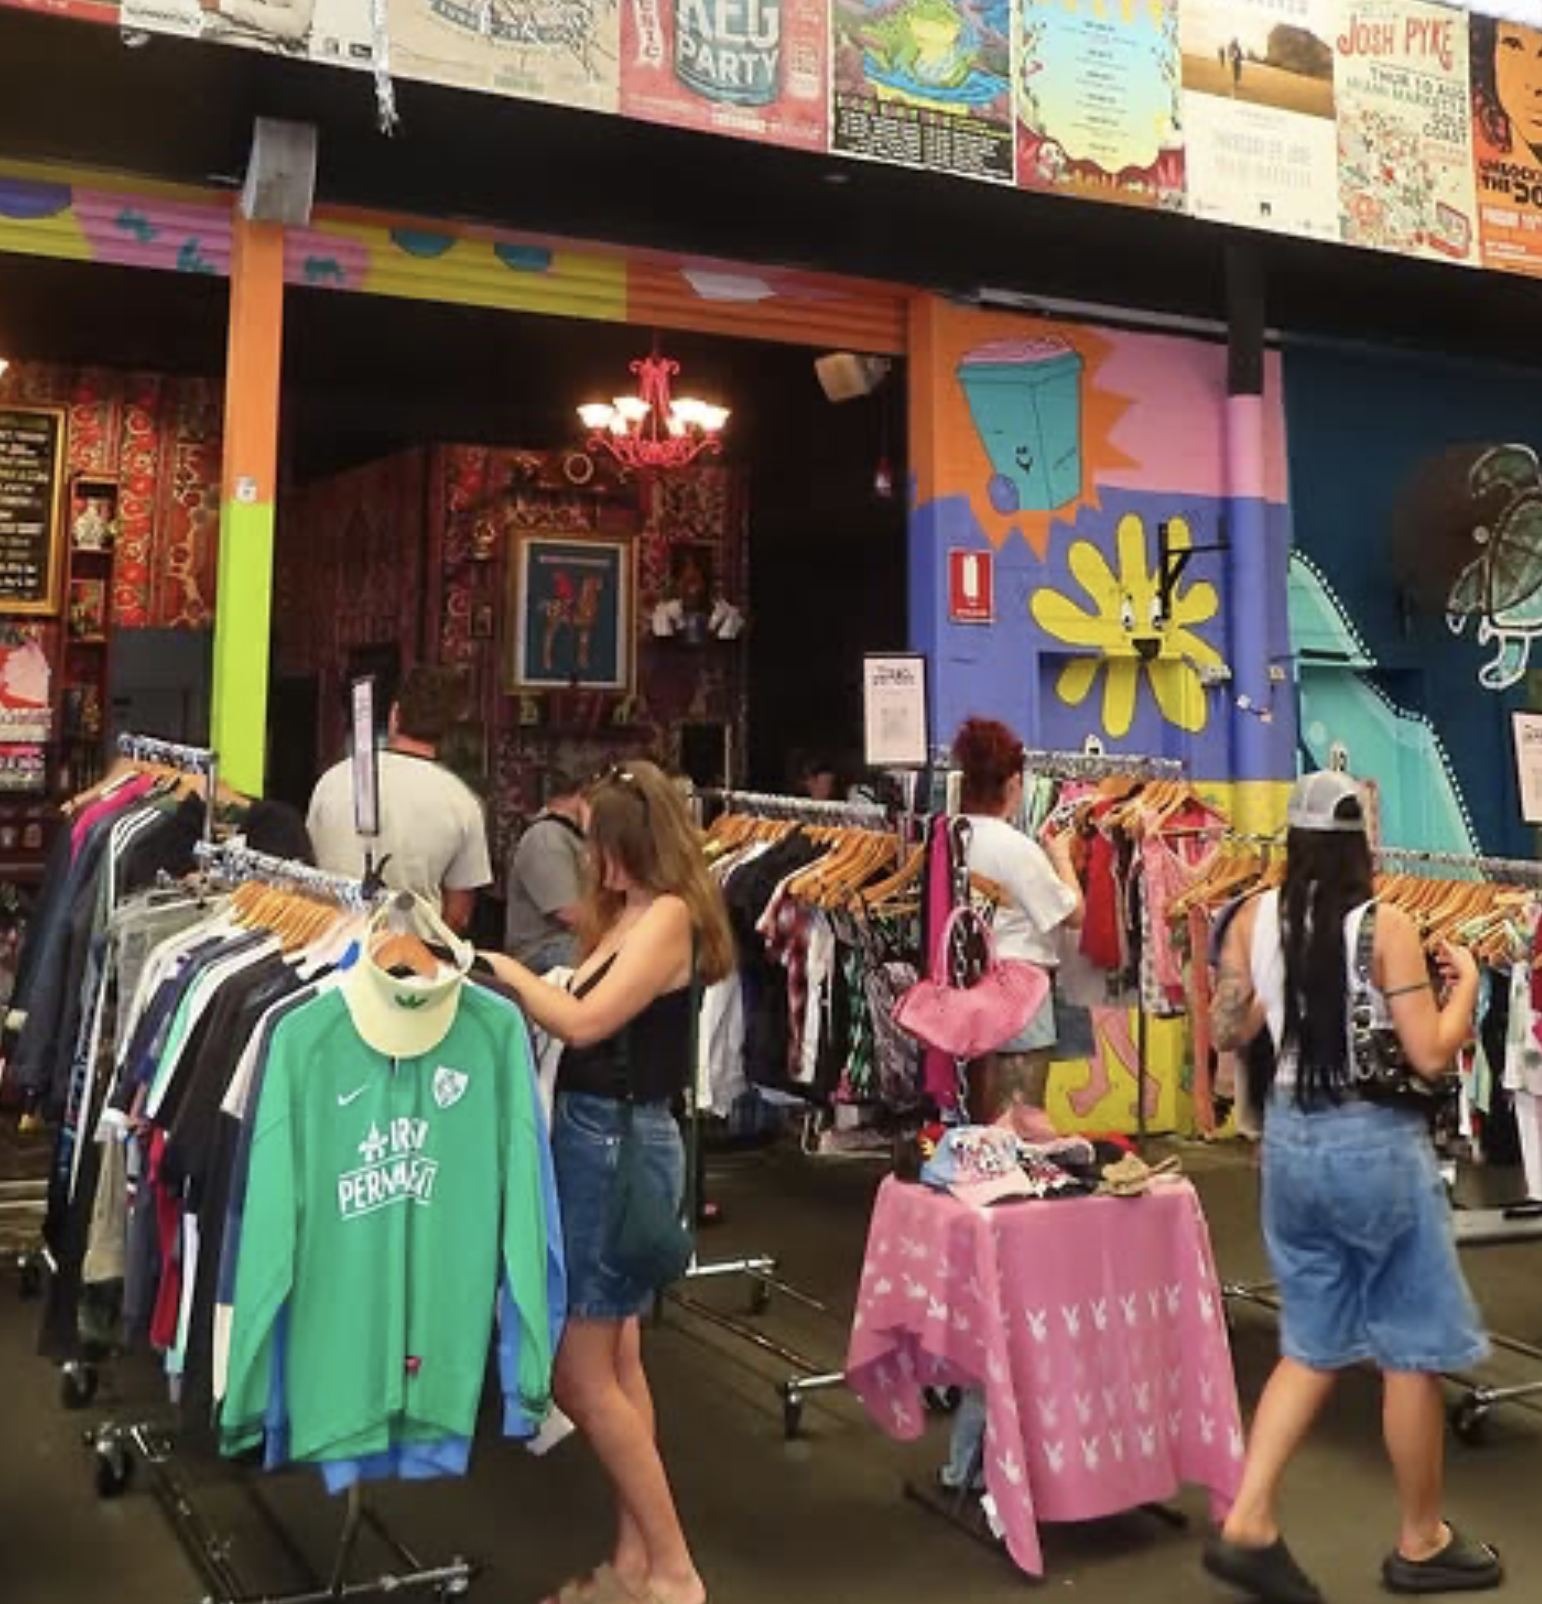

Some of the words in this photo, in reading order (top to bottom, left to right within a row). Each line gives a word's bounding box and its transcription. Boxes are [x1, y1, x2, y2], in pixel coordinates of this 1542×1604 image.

[676, 29, 781, 86] PARTY
[1338, 12, 1394, 56] JOSH
[1405, 16, 1453, 70] PYKE
[1482, 176, 1510, 193] THE
